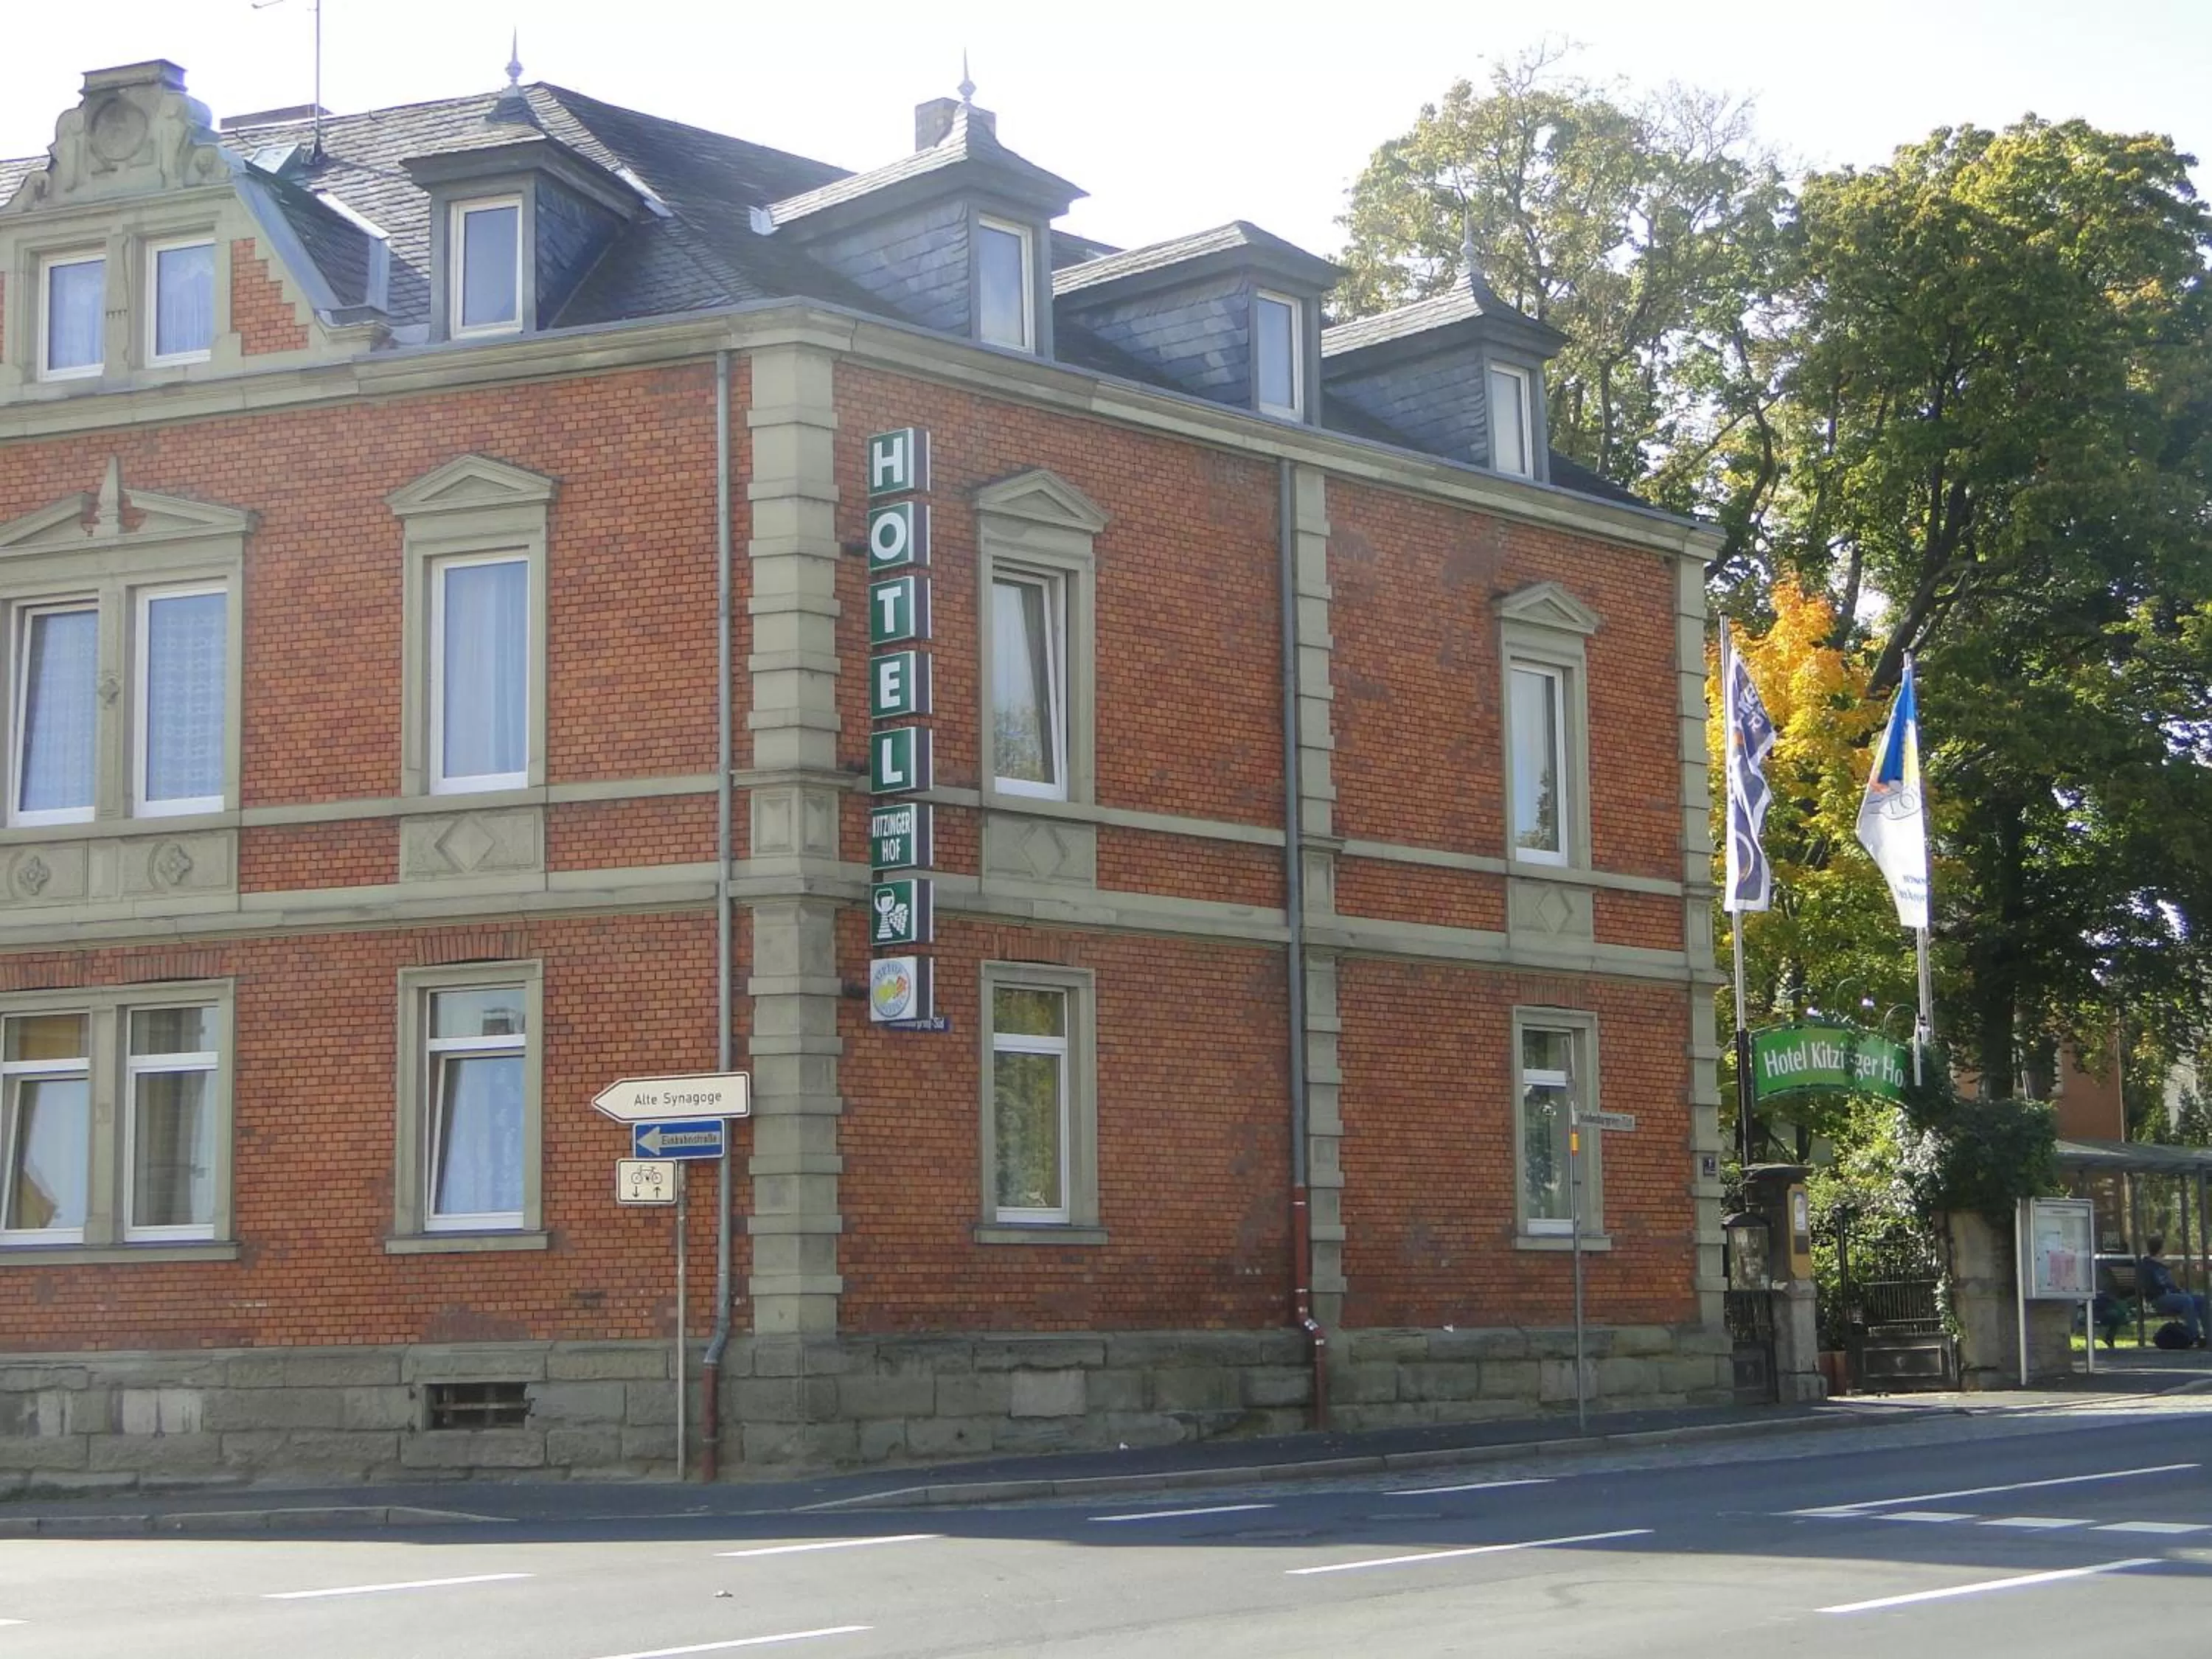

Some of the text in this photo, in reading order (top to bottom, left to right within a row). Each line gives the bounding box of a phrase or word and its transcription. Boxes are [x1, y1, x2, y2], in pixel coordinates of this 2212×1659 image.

[871, 437, 907, 785] HOTEL
[872, 812, 911, 838] KITZINGER
[882, 838, 900, 862] HOF
[1764, 1040, 1907, 1089] Hotel Kitziger Ho
[634, 1092, 722, 1106] Alte Synagoge
